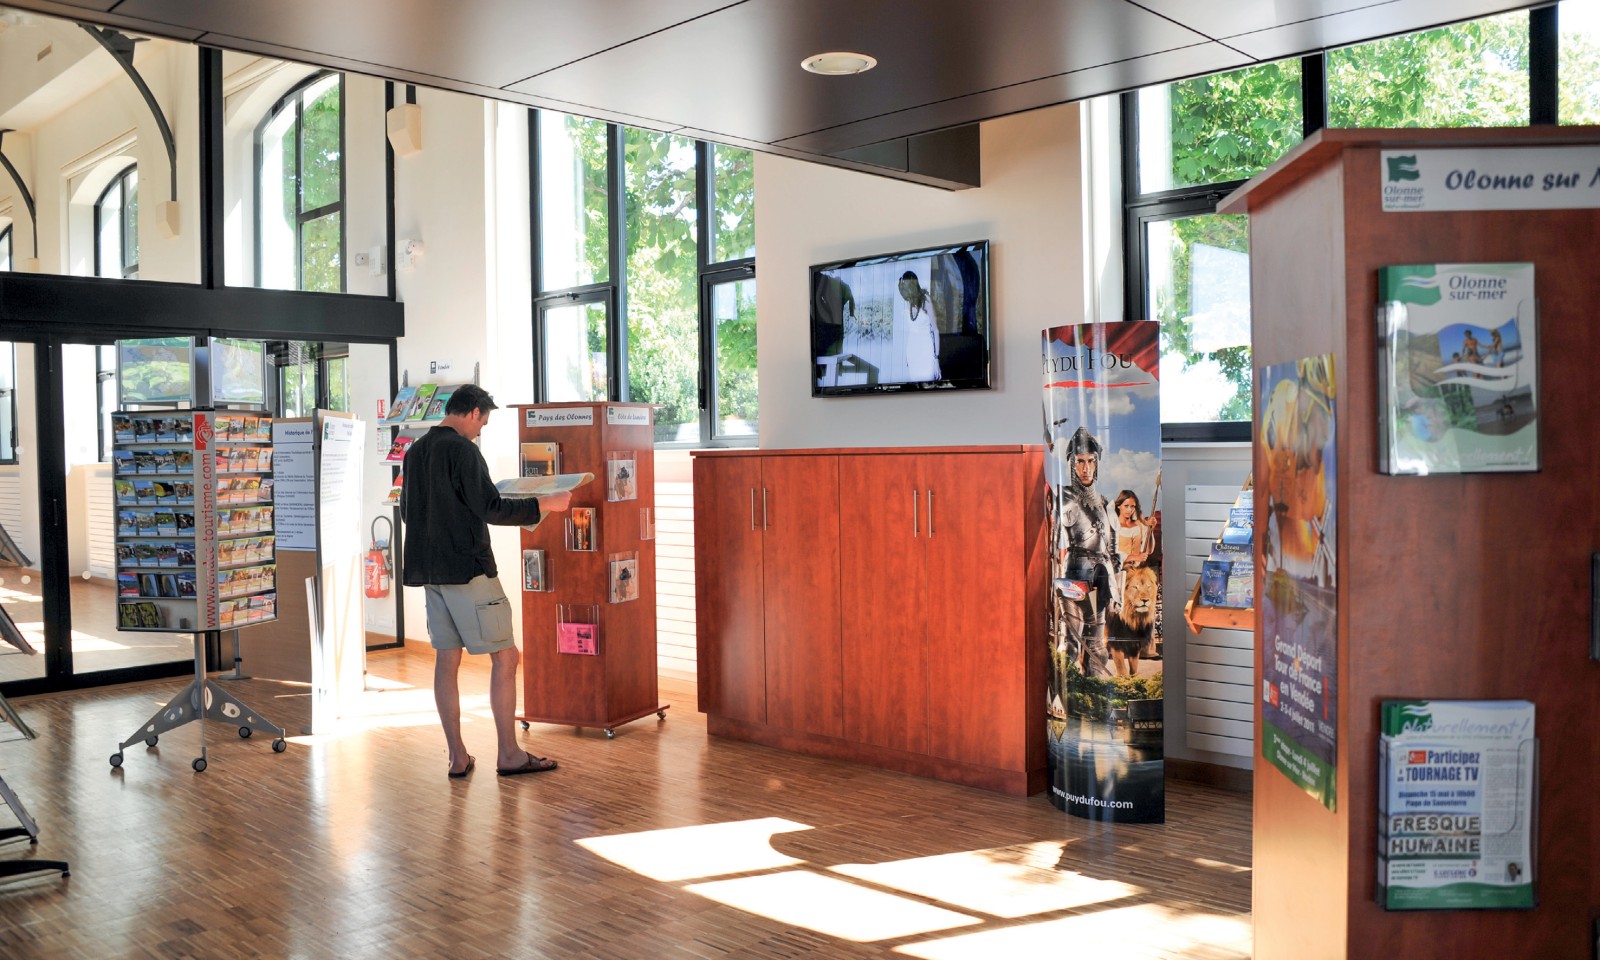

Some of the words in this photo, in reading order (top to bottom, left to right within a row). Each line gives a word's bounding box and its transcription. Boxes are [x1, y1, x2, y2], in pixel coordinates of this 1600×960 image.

[1445, 168, 1534, 191] Olonne
[1542, 172, 1581, 192] sur
[1384, 185, 1424, 195] Olonne
[1448, 275, 1508, 290] Olonne
[1449, 289, 1508, 301] sur-mer
[1087, 347, 1134, 370] FOU
[555, 413, 566, 421] des
[566, 413, 592, 421] Olonnes
[1274, 634, 1297, 658] Grand
[1297, 644, 1322, 673] Départ
[1274, 653, 1288, 675] Tour
[1298, 666, 1322, 694] France
[1280, 681, 1290, 697] en
[1289, 681, 1315, 713] Vendée
[1401, 717, 1518, 735] Naturellement
[1427, 750, 1481, 766] Participez
[1406, 767, 1460, 782] TOURNAGE
[1464, 767, 1480, 781] TV
[1052, 785, 1134, 809] www.puydufou.com
[1392, 815, 1480, 832] FRESQUE
[1390, 837, 1480, 853] HUMAINE
